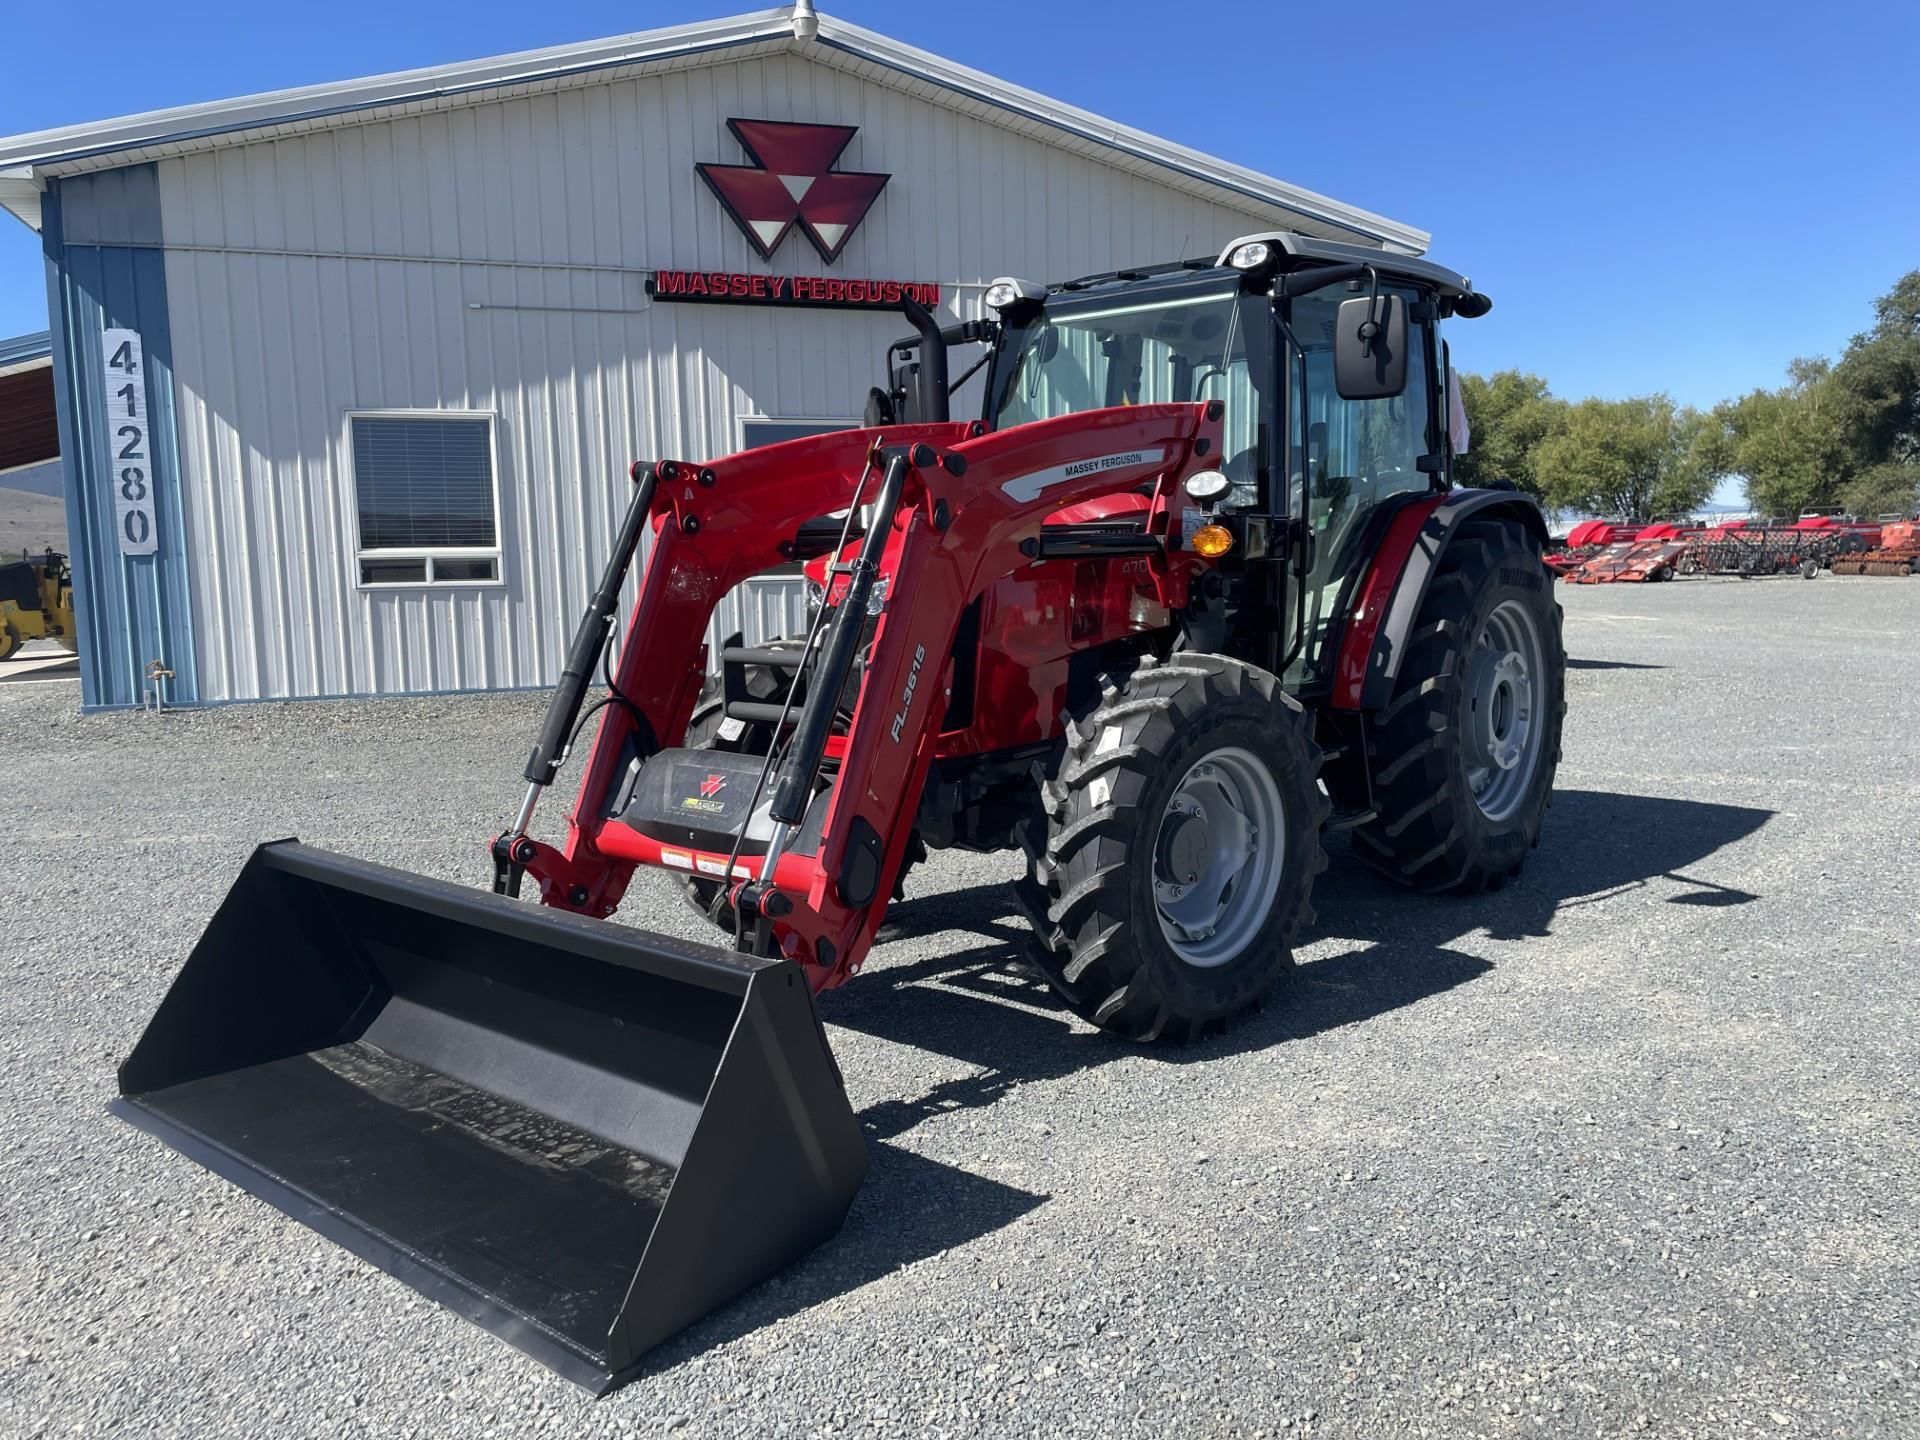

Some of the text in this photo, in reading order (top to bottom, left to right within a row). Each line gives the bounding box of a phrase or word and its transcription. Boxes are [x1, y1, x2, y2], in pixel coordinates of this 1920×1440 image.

[656, 270, 940, 305] MASSEY FERGUSON
[109, 340, 150, 544] 41280
[1065, 453, 1142, 477] MASSEY FERGUSON
